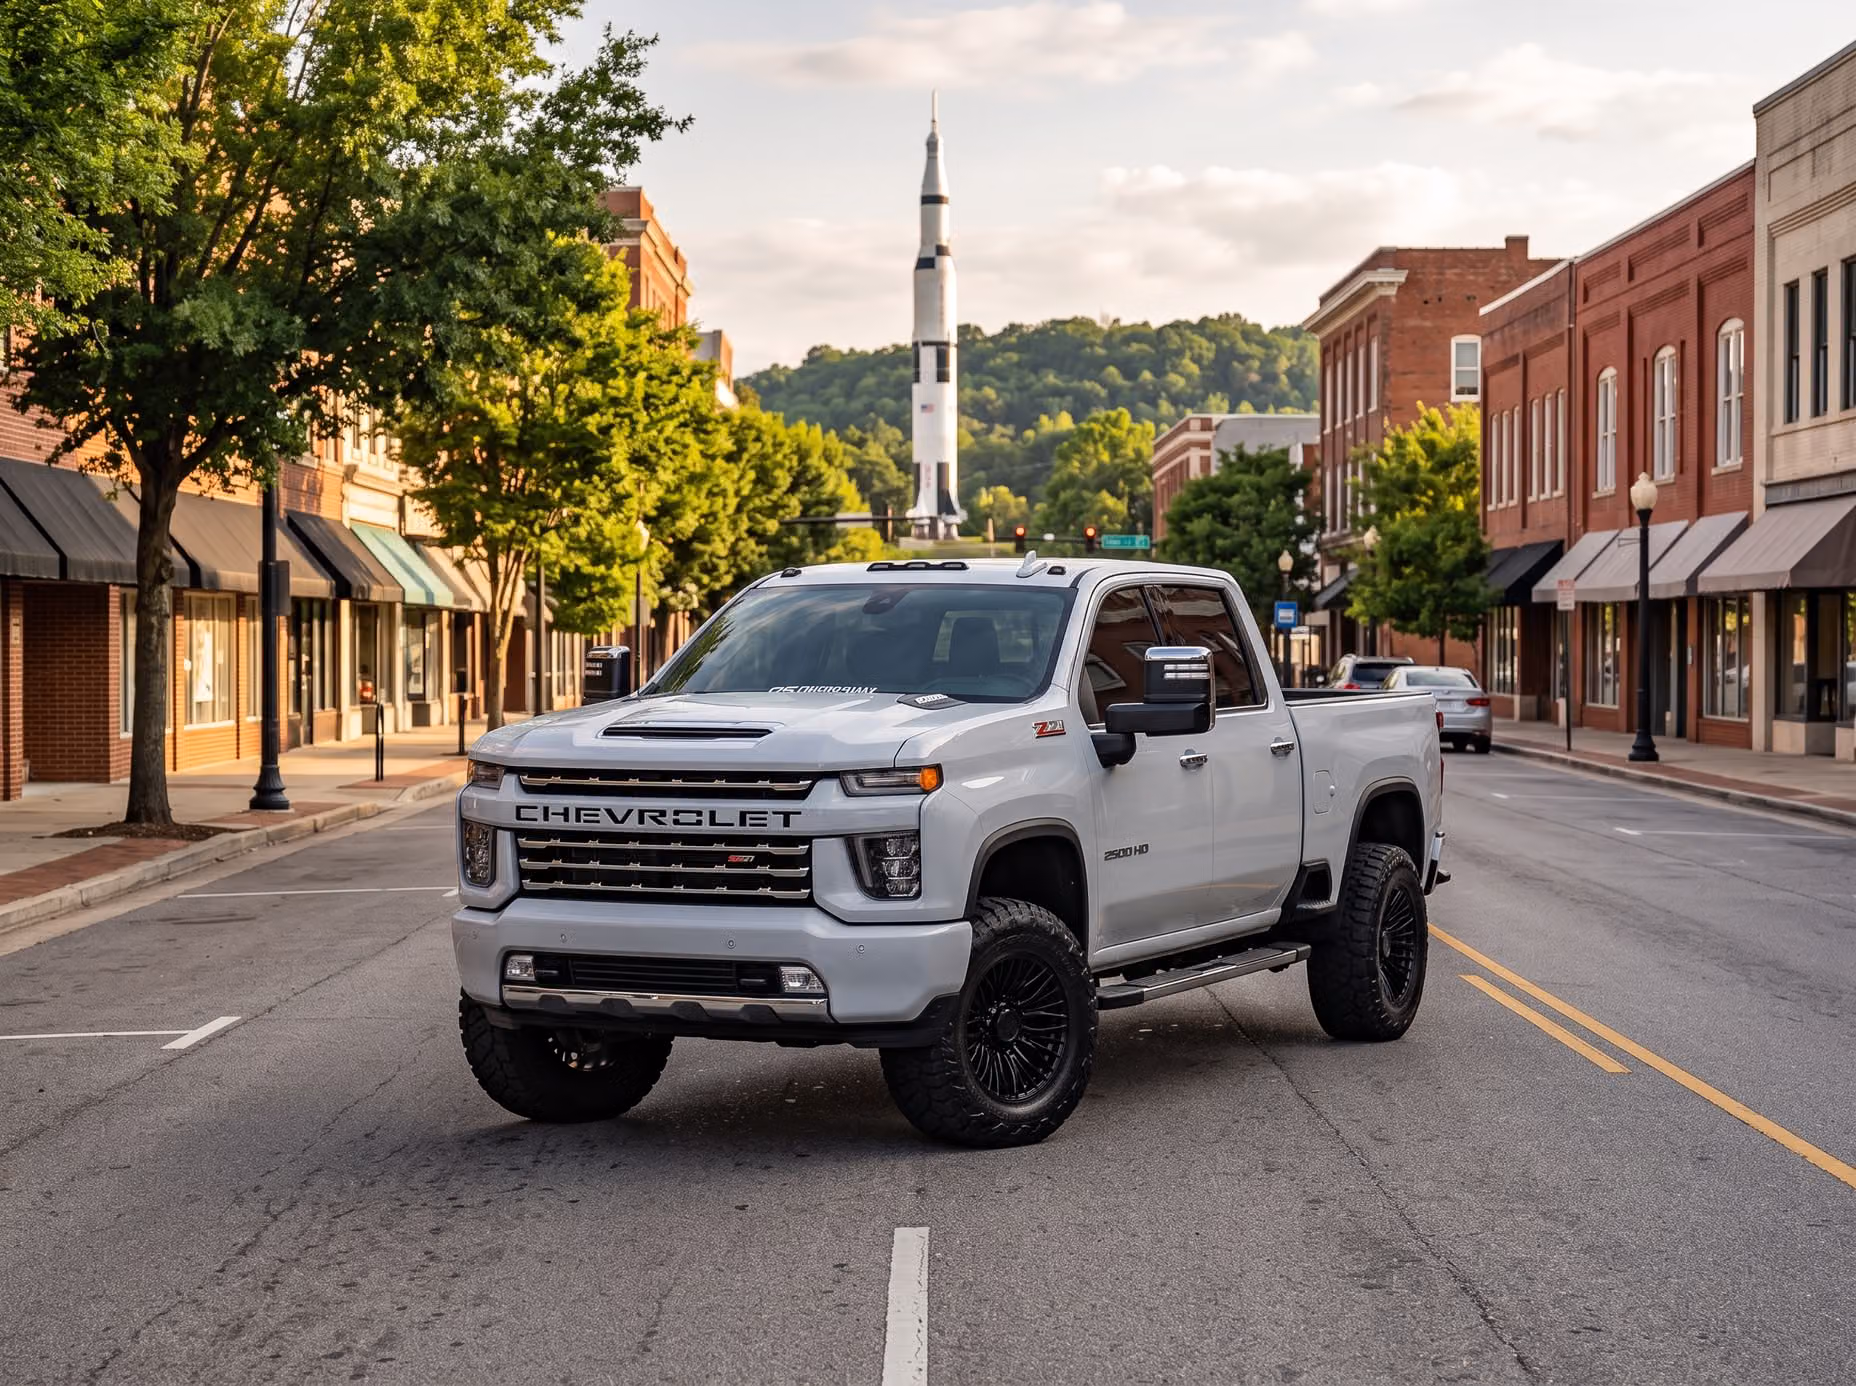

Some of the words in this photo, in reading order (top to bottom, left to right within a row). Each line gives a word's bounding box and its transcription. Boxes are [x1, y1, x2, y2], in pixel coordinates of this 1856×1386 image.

[515, 805, 802, 828] CHEVROLET
[1104, 846, 1132, 861] 2500
[1134, 844, 1149, 856] HD
